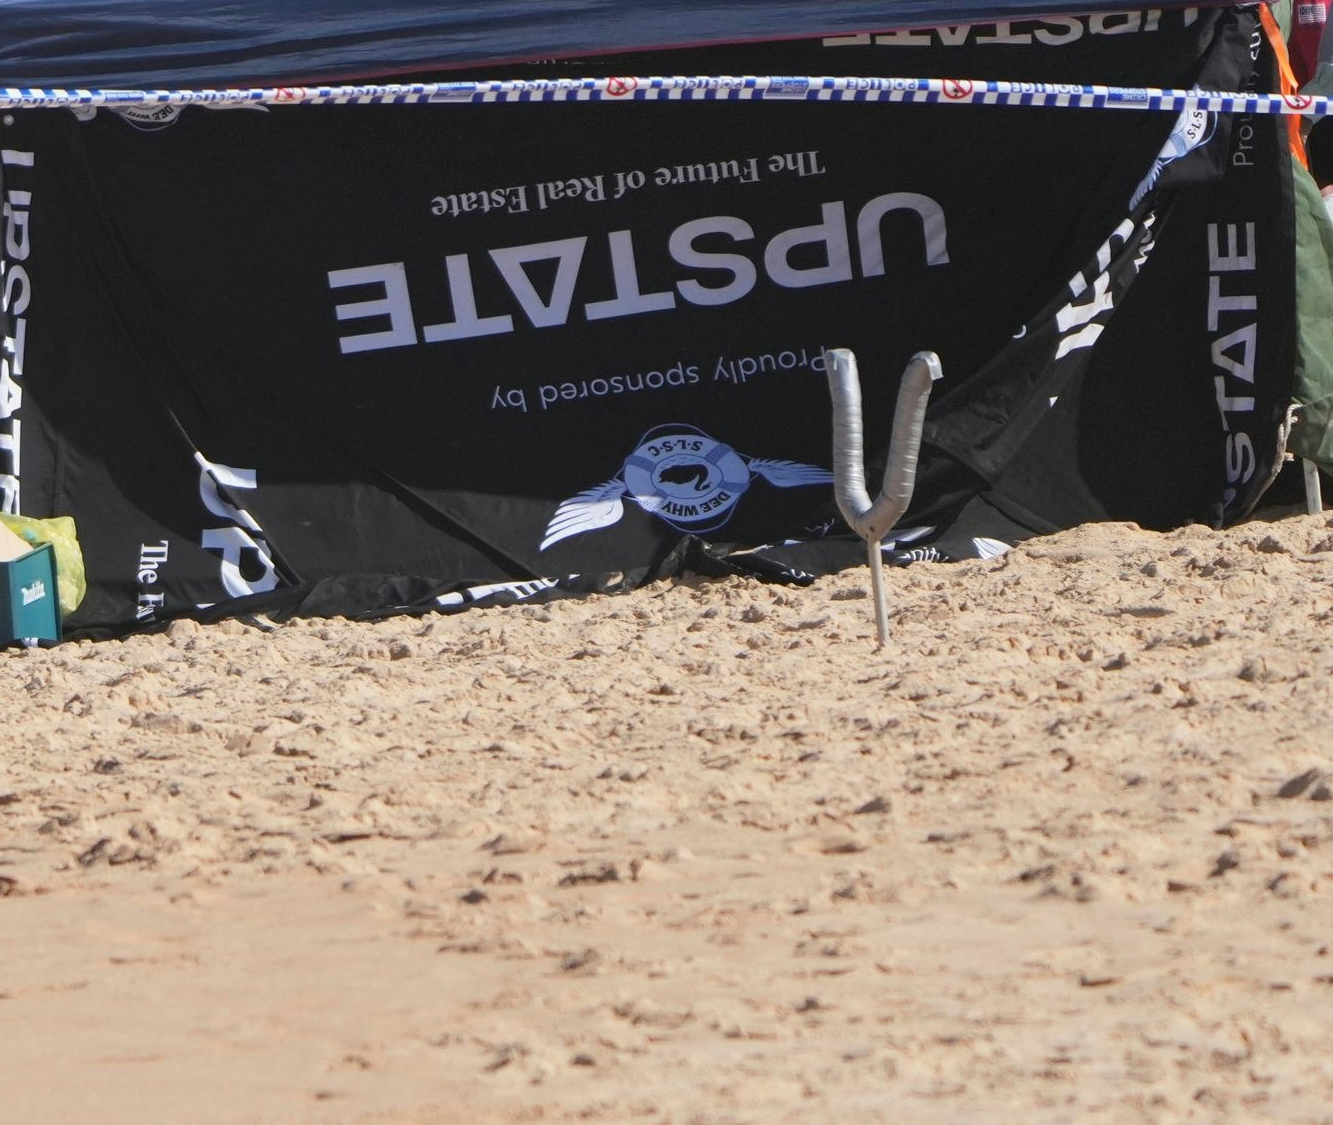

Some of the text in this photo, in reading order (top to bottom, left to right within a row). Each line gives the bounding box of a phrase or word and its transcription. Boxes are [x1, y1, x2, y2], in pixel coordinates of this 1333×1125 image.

[846, 78, 917, 91] POLICE
[431, 150, 827, 218] The Future of Real Estate
[327, 191, 950, 355] UPSTATE
[491, 346, 828, 413] Proudly sponsored by
[1207, 221, 1258, 505] STATE
[661, 490, 732, 517] DEE WHY
[137, 539, 169, 585] The
